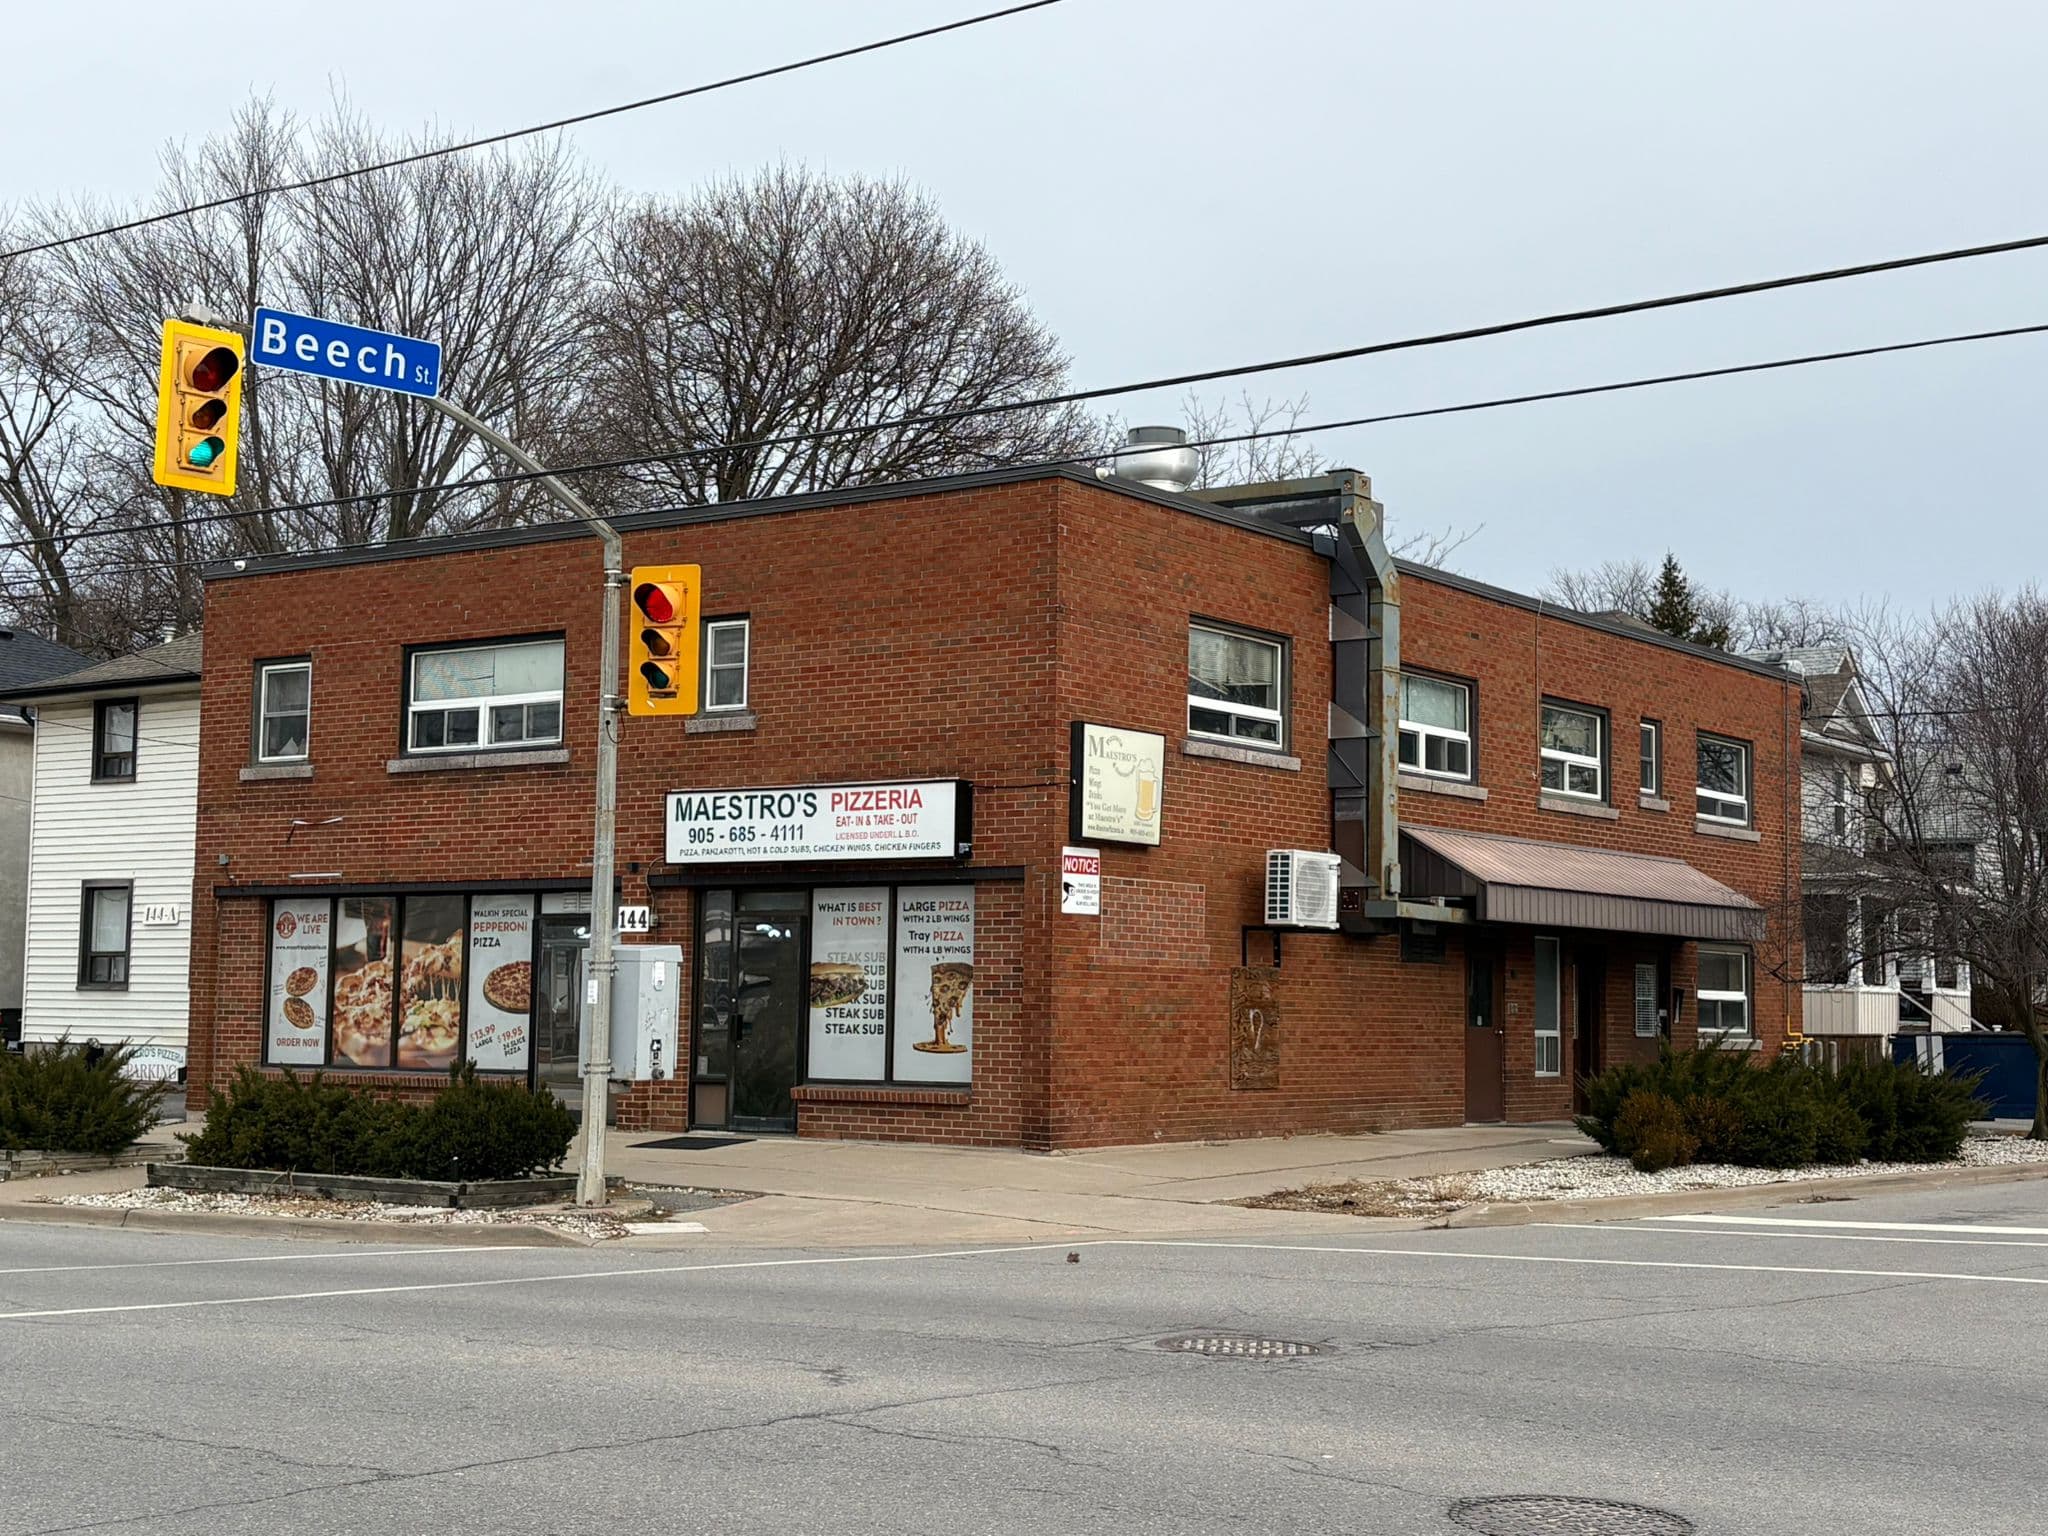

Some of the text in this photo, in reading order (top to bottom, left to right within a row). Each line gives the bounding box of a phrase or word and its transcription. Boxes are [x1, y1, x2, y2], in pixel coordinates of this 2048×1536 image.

[262, 318, 433, 386] Beech St.
[675, 789, 923, 822] MAESTRO'S PIZZERIA
[865, 815, 871, 826] &
[688, 827, 714, 844] 905
[729, 825, 756, 842] 685
[770, 824, 804, 841] 4111
[836, 831, 868, 841] LICENSED
[747, 847, 760, 855] HOT
[770, 845, 788, 854] COLD
[813, 844, 845, 853] CHICKEN
[875, 843, 907, 851] CHICKEN
[909, 842, 941, 850] FINGERS
[1064, 857, 1098, 873] NOTICE
[818, 902, 882, 912] WHAT IS BEST
[903, 901, 970, 912] LARGE PIZZA
[297, 913, 328, 923] WE ARE
[502, 909, 528, 917] SPECIAL
[903, 914, 970, 923] WITH 2 LB WINGS
[619, 910, 647, 928] 144
[833, 916, 843, 926] IN
[303, 924, 321, 935] LIVE
[474, 921, 528, 932] PEPPERONI
[473, 937, 501, 948] PIZZA
[908, 931, 964, 943] Tray PIZZA
[903, 946, 924, 954] WITH
[932, 946, 943, 954] LB
[944, 946, 972, 954] WINGS
[827, 952, 886, 962] STEAK SUB
[864, 965, 886, 976] SUB
[863, 994, 885, 1005] SUB
[825, 1007, 885, 1020] STEAK SUB
[825, 1023, 885, 1035] STEAK SUB
[276, 1037, 320, 1048] ORDER NOW
[474, 1036, 493, 1049] LARGE
[127, 1063, 177, 1079] PARKING
